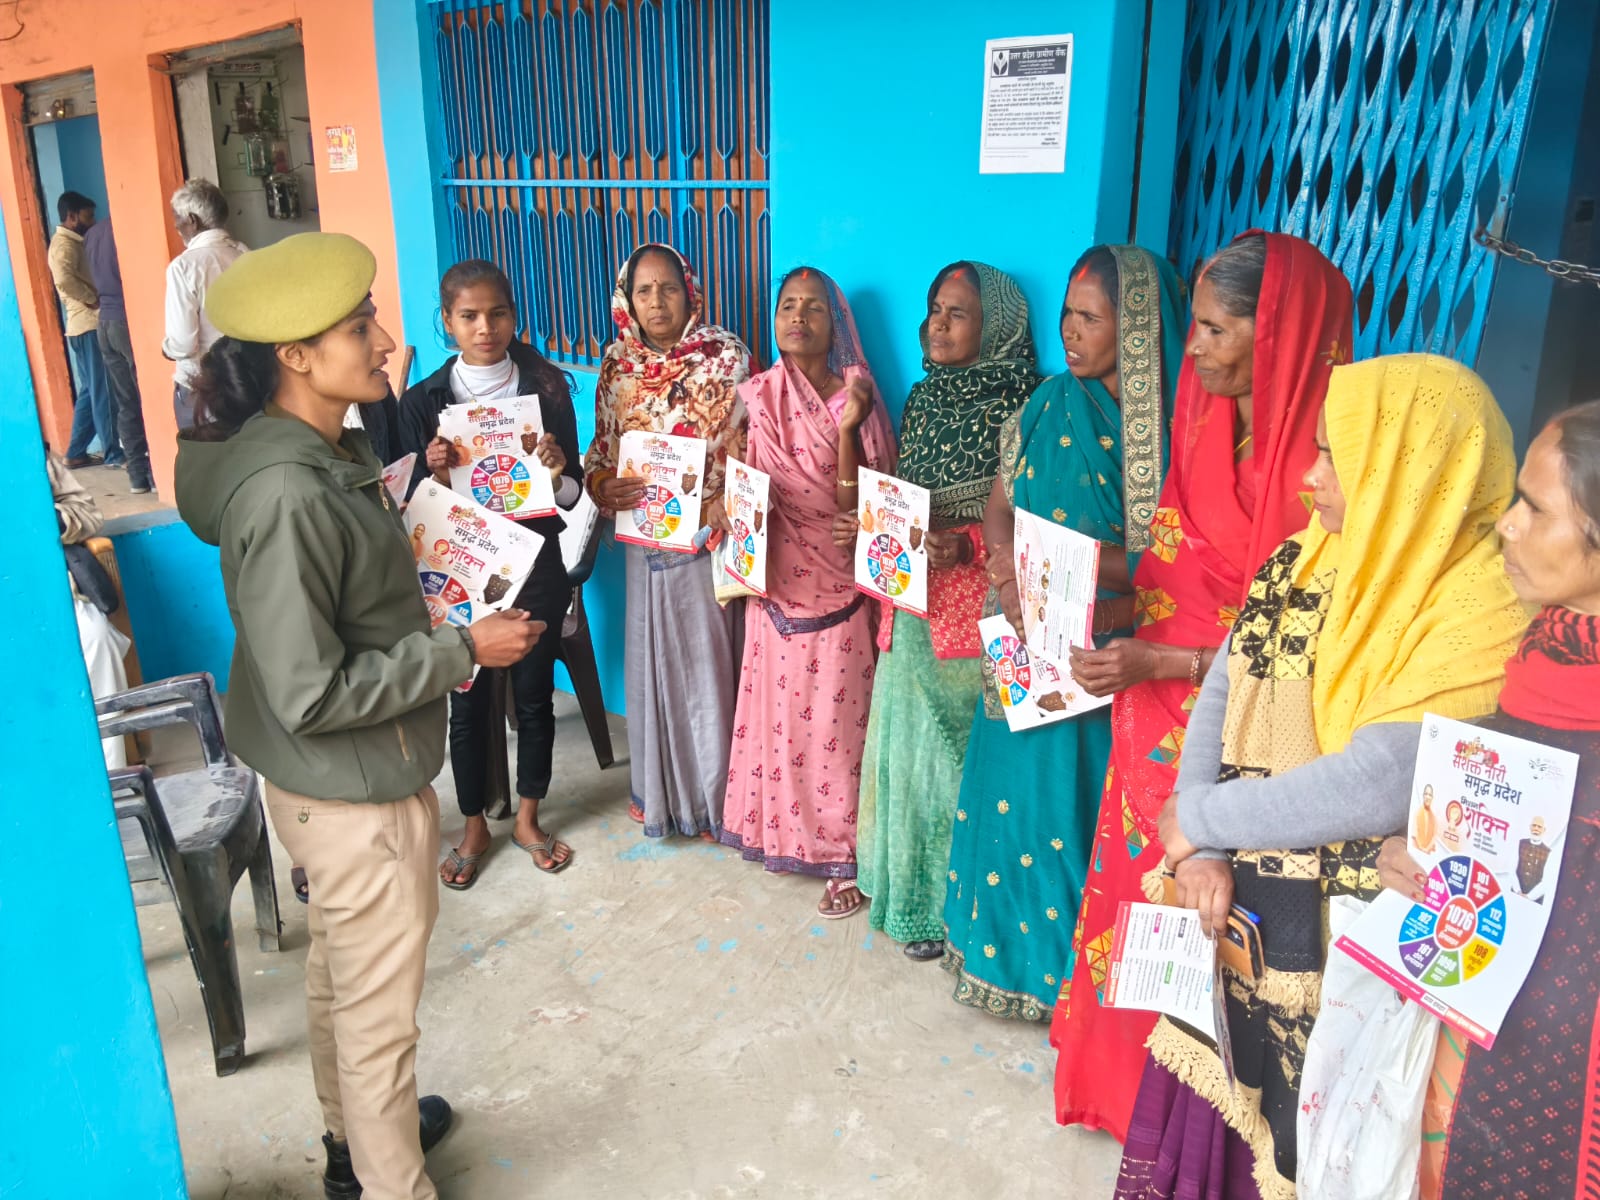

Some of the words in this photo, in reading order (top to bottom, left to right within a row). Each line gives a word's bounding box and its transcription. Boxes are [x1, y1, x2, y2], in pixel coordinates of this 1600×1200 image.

[1022, 49, 1035, 59] प्रदेश
[1036, 48, 1054, 58] ग्रामीण
[1055, 47, 1066, 56] बैंक
[455, 526, 478, 546] समृद्ध
[478, 538, 500, 556] प्रदेश
[1452, 754, 1482, 776] सशक्त
[1484, 764, 1507, 784] नारी
[1464, 773, 1492, 798] समृद्ध
[1493, 781, 1522, 805] प्रदेश
[1450, 860, 1468, 876] 1930
[1428, 878, 1445, 894] 1090
[1477, 871, 1490, 886] 101
[1446, 904, 1475, 932] 1076
[1490, 908, 1502, 922] 112
[1473, 944, 1488, 958] 108
